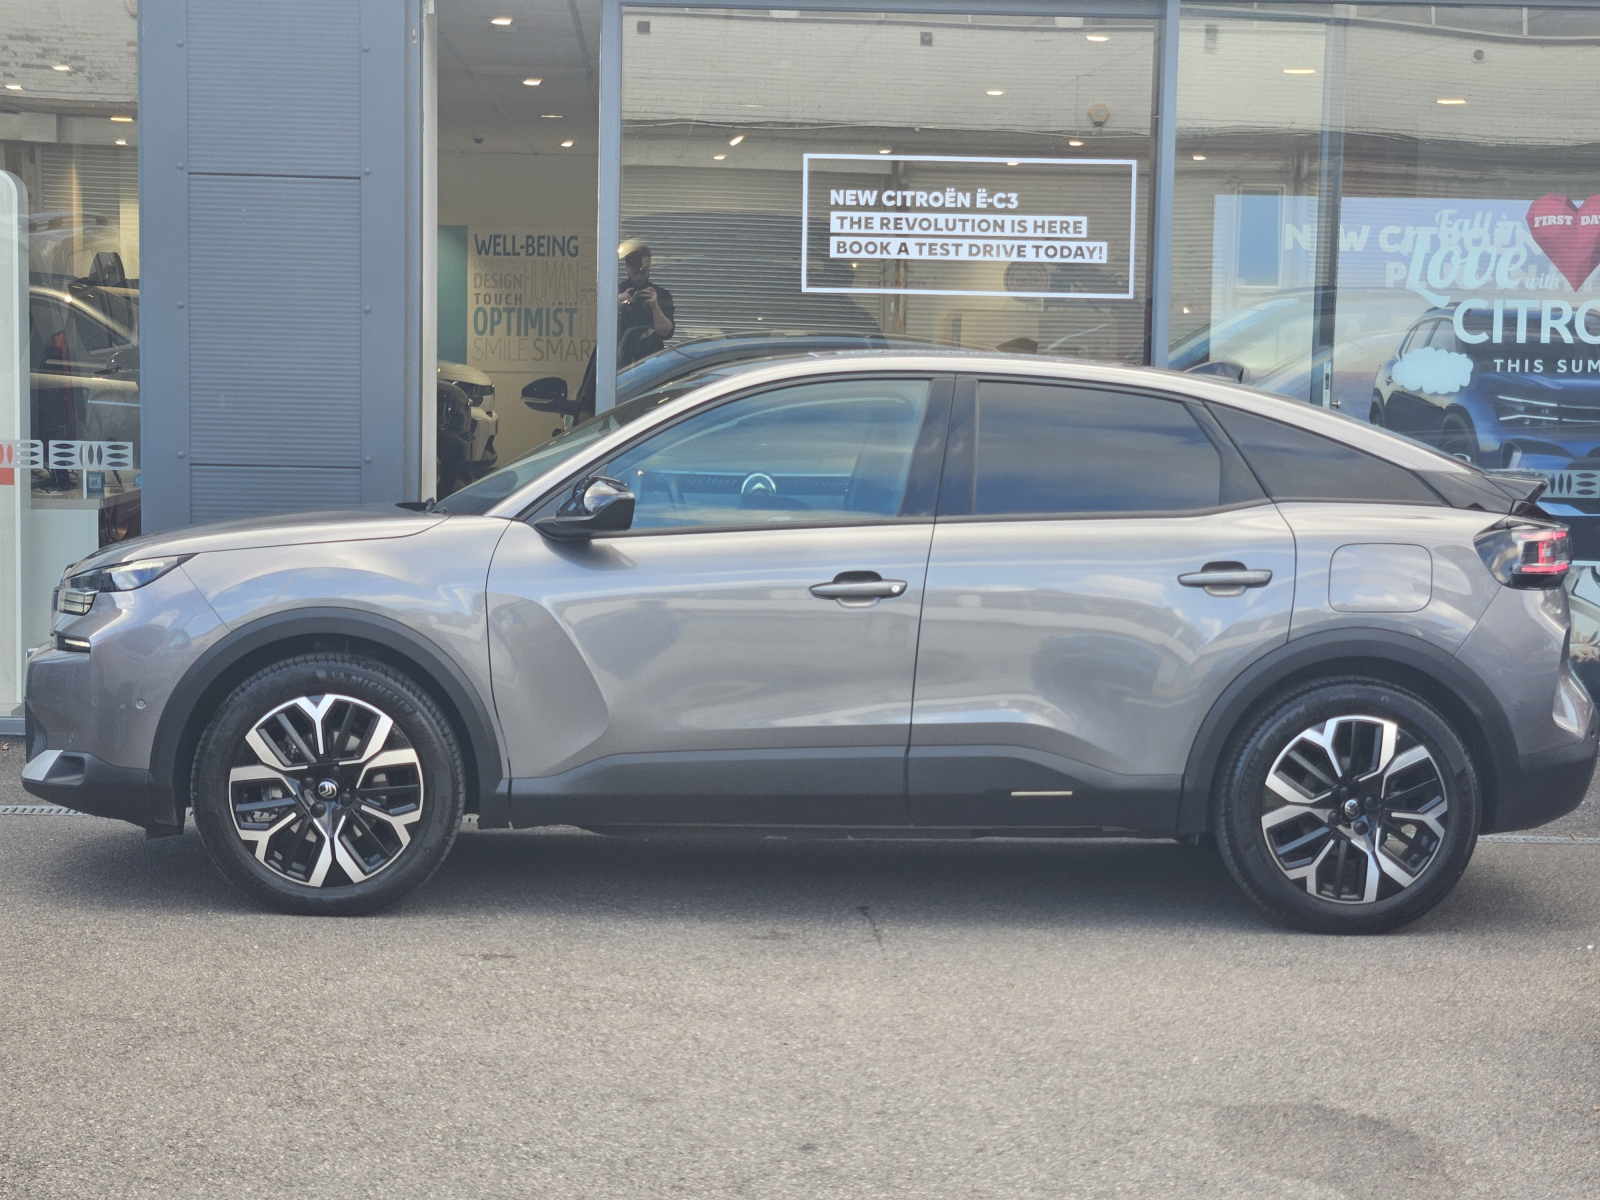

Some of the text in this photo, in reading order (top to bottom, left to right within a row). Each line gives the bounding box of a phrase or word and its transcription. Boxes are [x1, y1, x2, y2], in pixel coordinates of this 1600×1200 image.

[830, 187, 1019, 209] NEW CITROËN Ë-C3
[836, 216, 1083, 234] THE REVOLUTION IS HERE
[1434, 208, 1523, 240] Fall in
[1533, 214, 1600, 228] FIRST DA
[474, 233, 579, 258] WELL-BEING
[1285, 223, 1371, 252] NW
[836, 240, 1103, 260] BOOK A TEST DRIVE TODAY!
[1400, 226, 1527, 308] Love
[473, 273, 522, 290] DESIGN
[524, 260, 579, 301] HUMAN
[1524, 270, 1560, 290] with
[474, 292, 522, 306] TOUCH
[473, 307, 578, 337] OPTIMIST
[472, 338, 528, 362] SMILE
[532, 338, 597, 362] SMAR
[1493, 359, 1600, 374] THIS SUM
